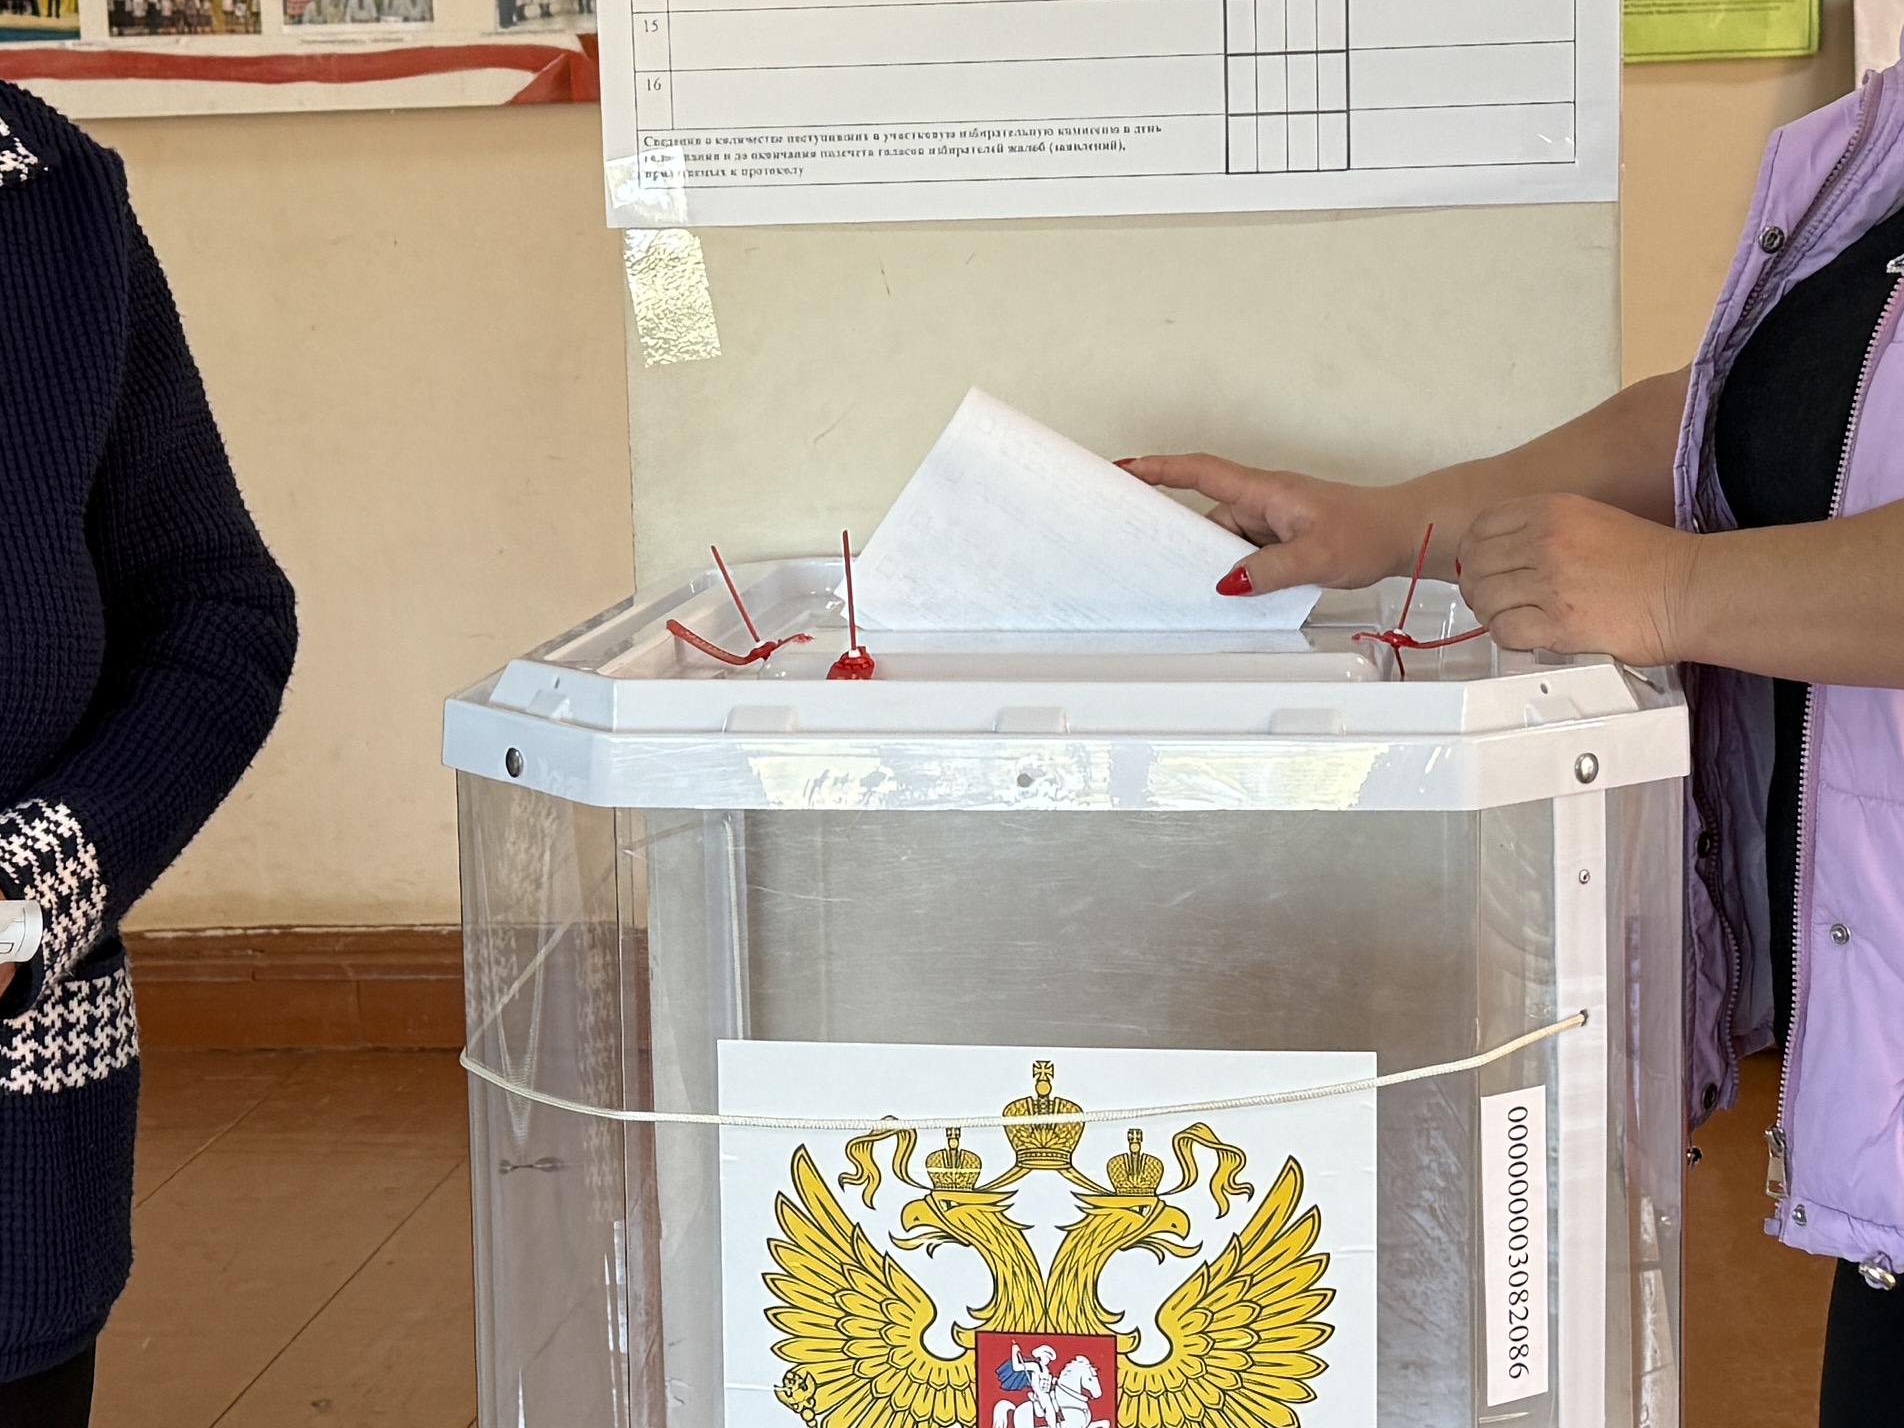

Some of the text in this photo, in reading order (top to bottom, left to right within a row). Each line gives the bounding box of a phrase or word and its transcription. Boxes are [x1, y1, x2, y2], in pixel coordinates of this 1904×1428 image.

[644, 20, 658, 32] 15
[648, 77, 661, 91] 16
[1507, 1106, 1529, 1380] 000000003082086
